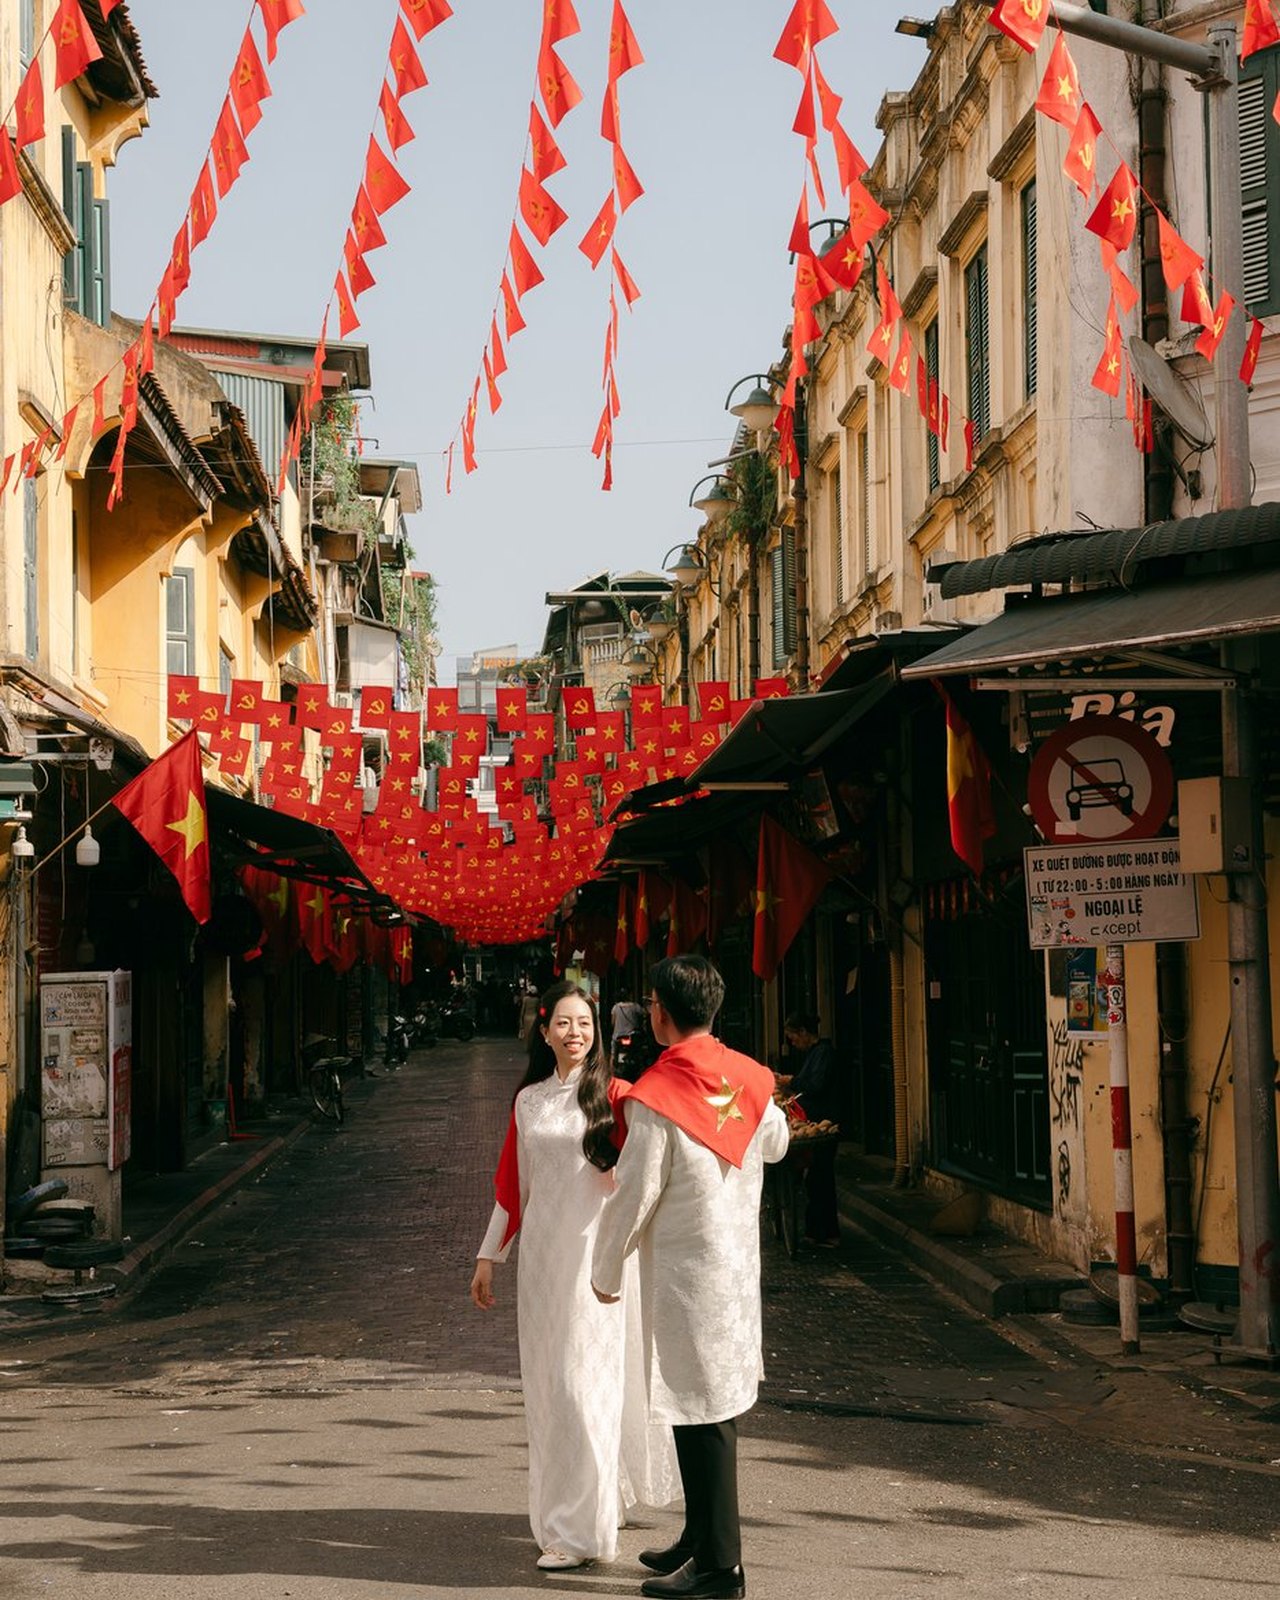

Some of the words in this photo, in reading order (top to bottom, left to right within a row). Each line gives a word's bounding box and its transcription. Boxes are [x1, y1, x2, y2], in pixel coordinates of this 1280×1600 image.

[1032, 859, 1044, 872] XE
[1046, 854, 1069, 871] QUÉT
[1106, 851, 1133, 868] ĐƯỢC
[1135, 851, 1159, 867] HOẠT
[1161, 847, 1181, 866] ĐỘN
[1124, 873, 1151, 889] HÀNG
[1084, 898, 1124, 918] NGOẠI
[1127, 894, 1143, 917] LỆ
